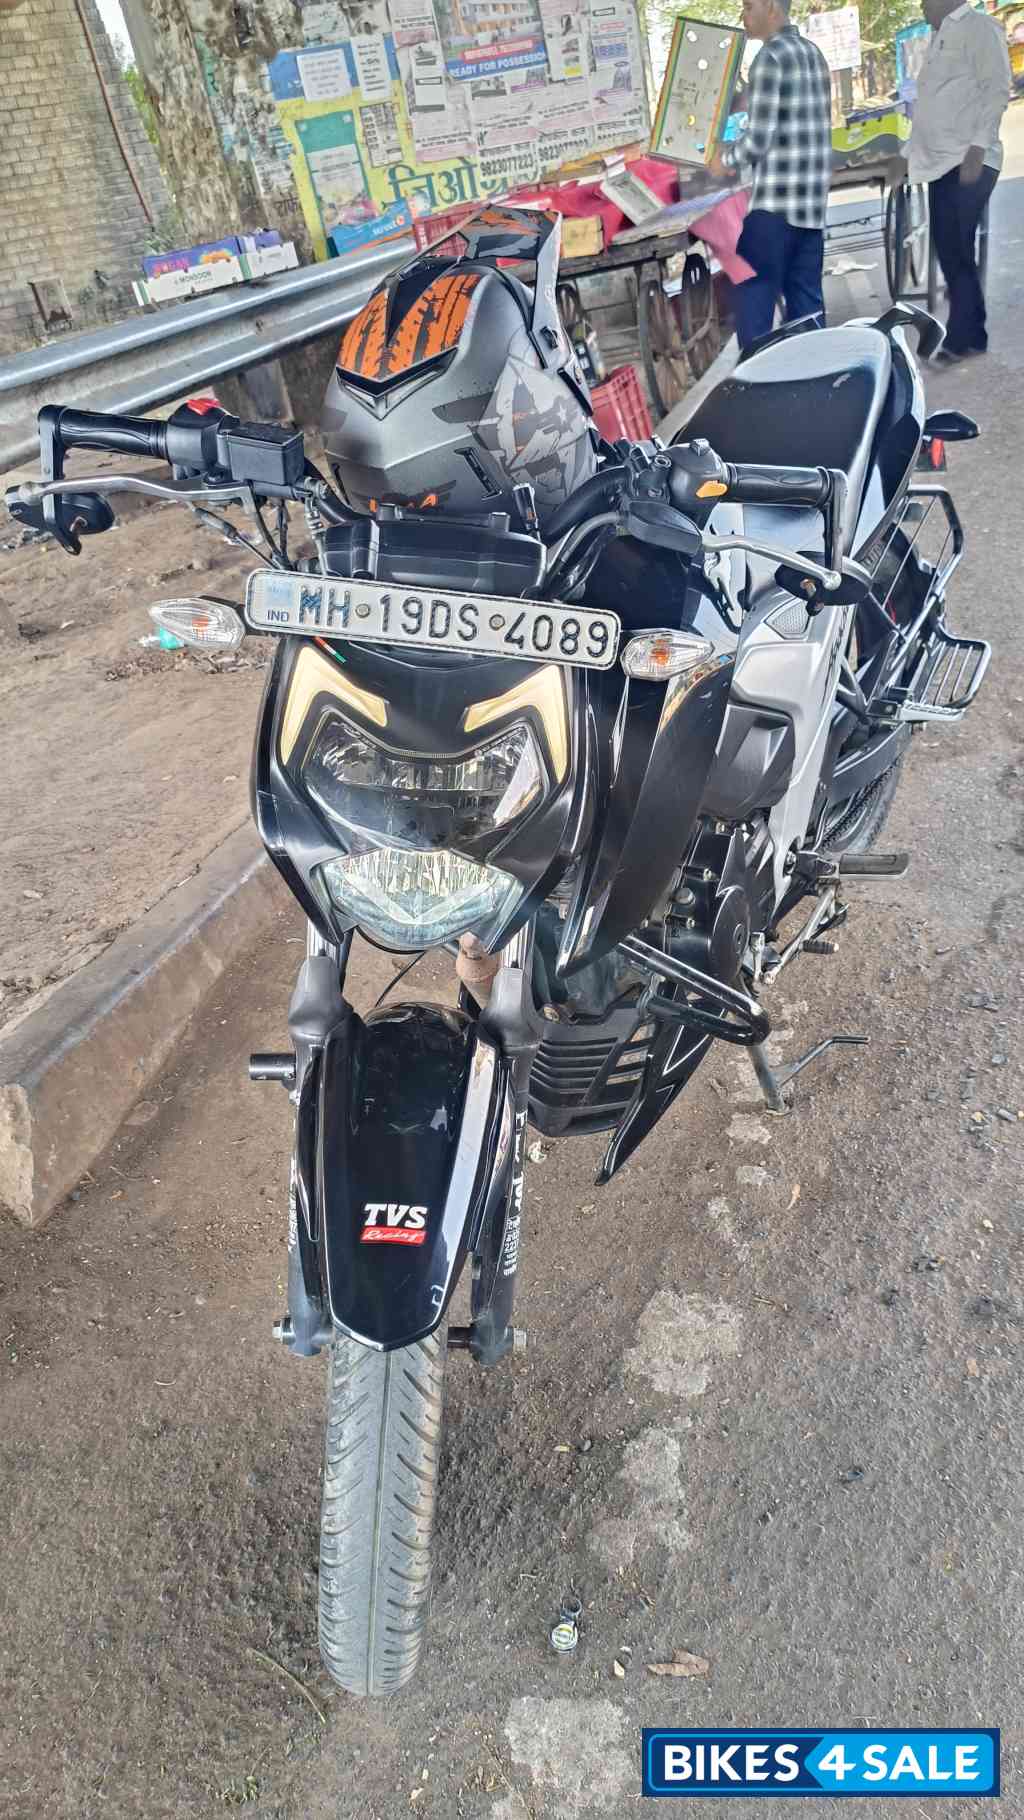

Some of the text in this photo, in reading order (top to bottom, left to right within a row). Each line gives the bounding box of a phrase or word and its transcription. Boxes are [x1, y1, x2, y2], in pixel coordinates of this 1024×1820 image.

[480, 154, 534, 177] 9823077223
[267, 609, 289, 622] IND
[299, 584, 609, 658] MH 19DS 4089
[363, 1203, 428, 1229] TVS
